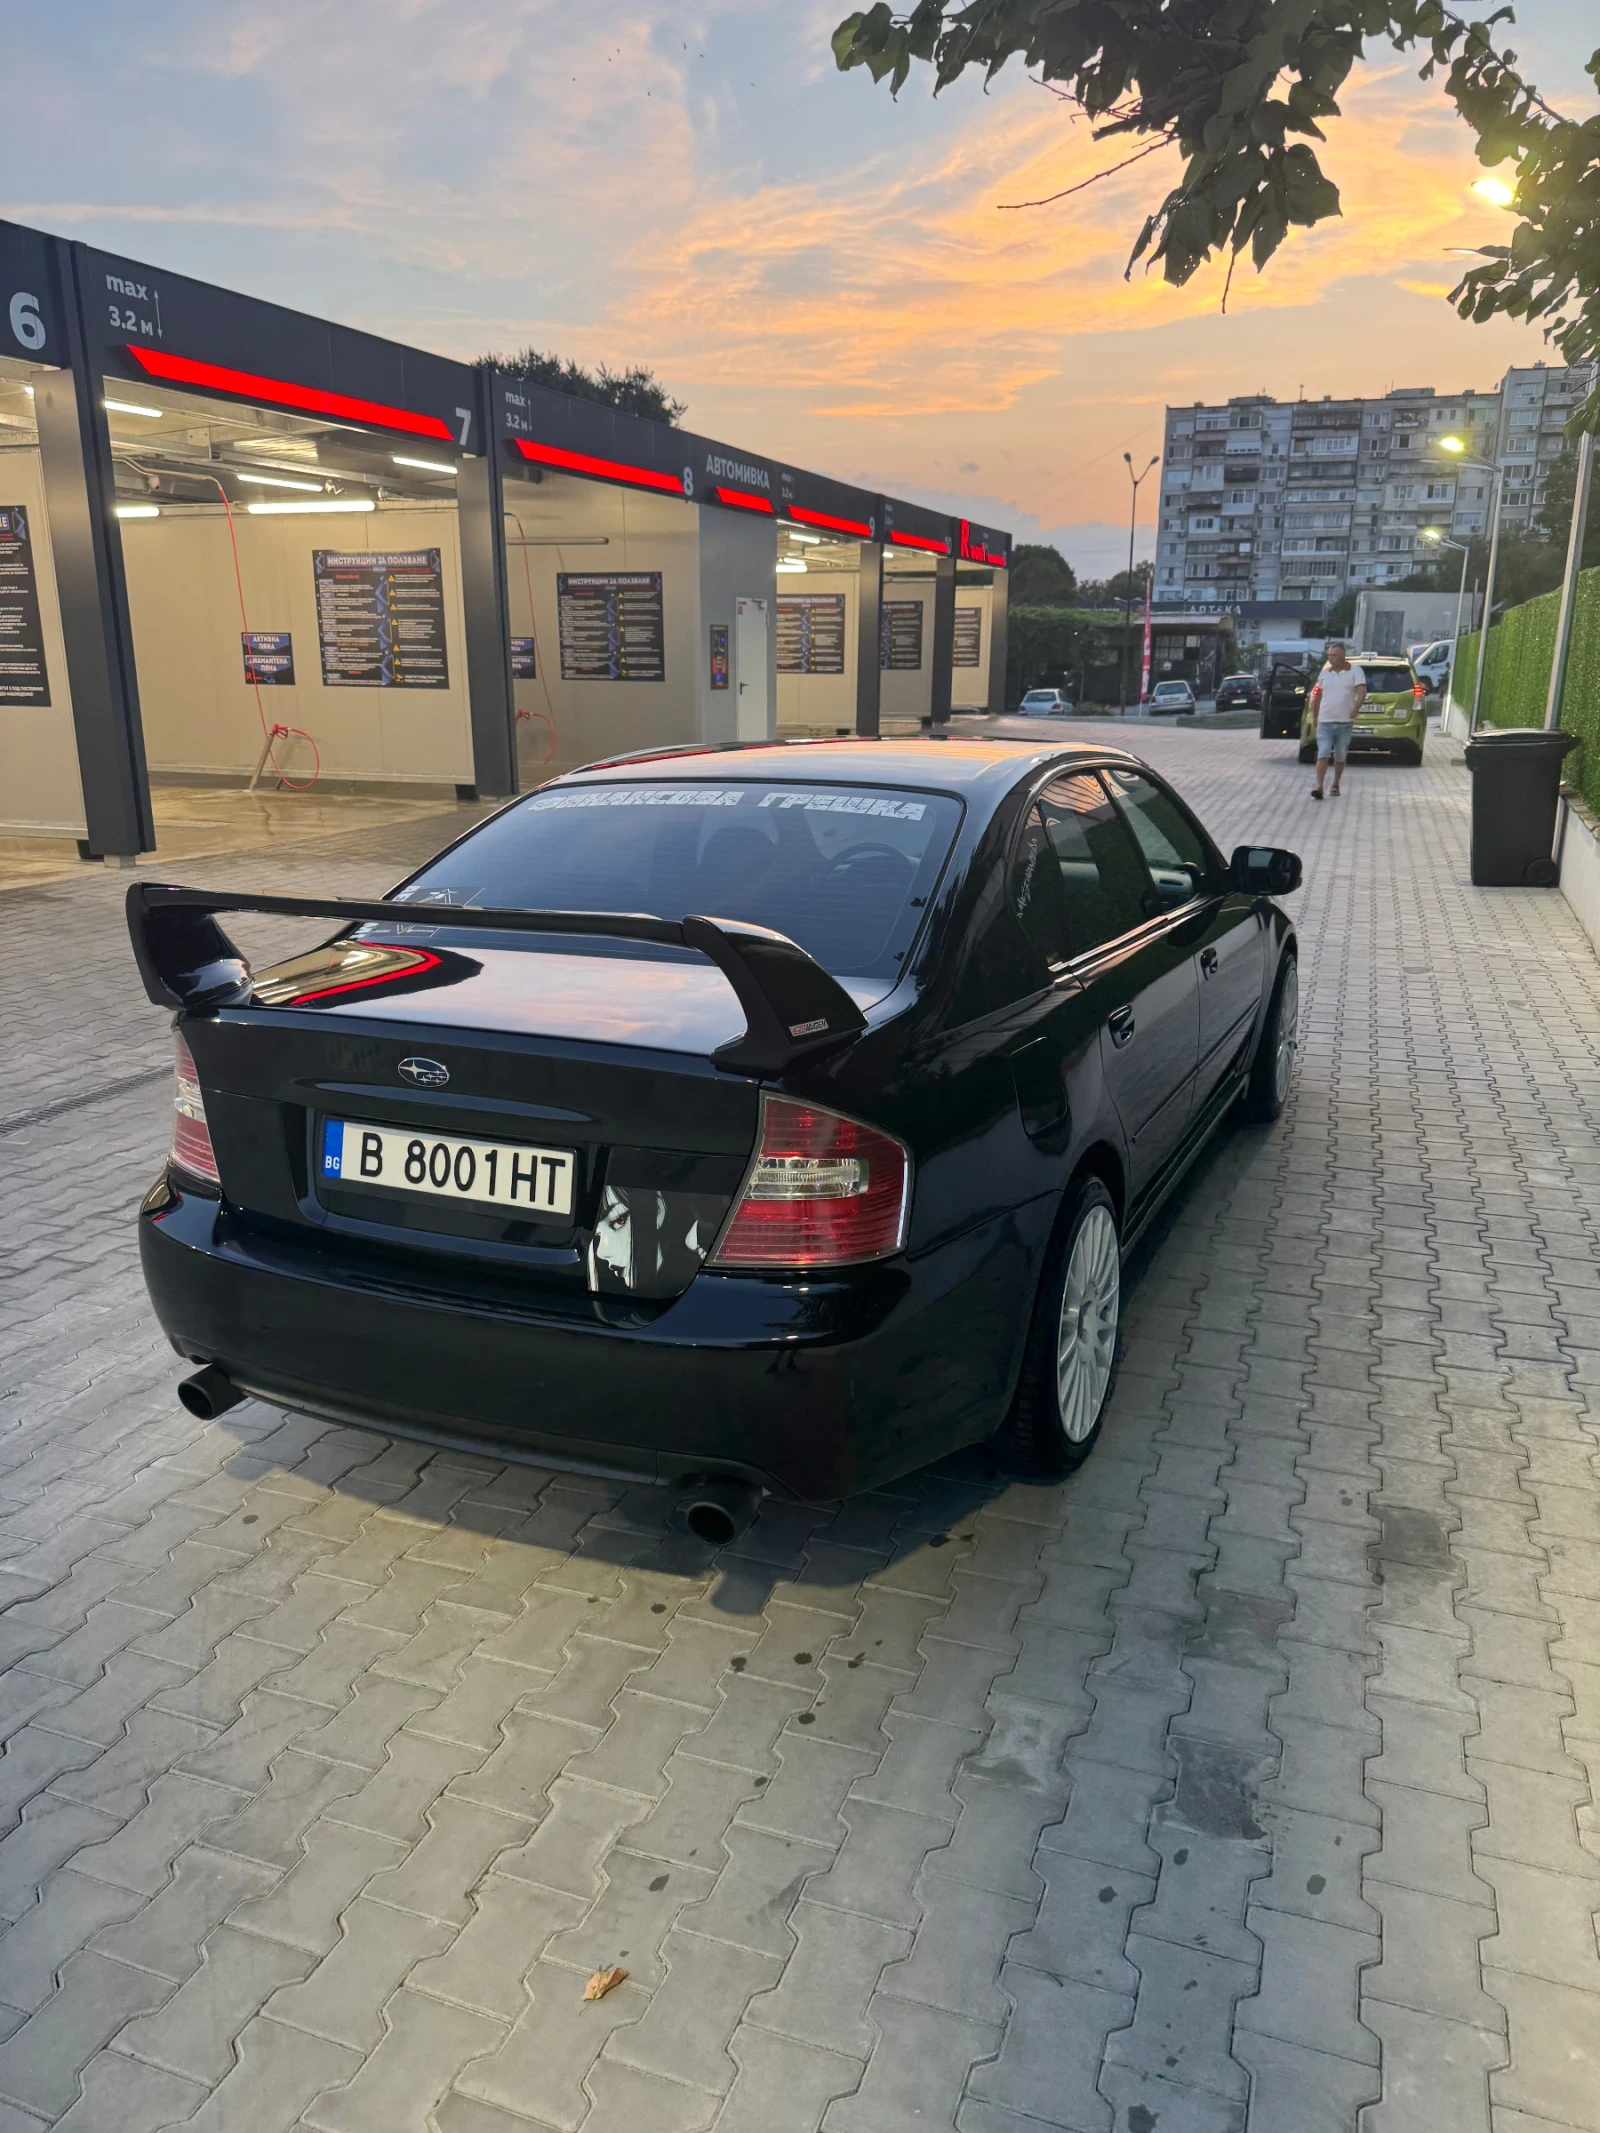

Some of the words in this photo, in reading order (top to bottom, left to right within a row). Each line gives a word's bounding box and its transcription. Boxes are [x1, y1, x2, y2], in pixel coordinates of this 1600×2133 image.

[105, 274, 149, 301] max
[9, 291, 47, 350] 6
[108, 305, 137, 332] 3.2
[505, 391, 526, 407] max
[455, 407, 471, 446] 7
[506, 412, 520, 429] 3.2
[683, 466, 694, 496] 8
[705, 454, 771, 489] АВТОМИВКА
[869, 516, 876, 538] 9
[960, 518, 970, 558] R
[327, 556, 377, 566] ИНСТРУКЦИИ
[378, 556, 387, 565] ЗА
[388, 555, 427, 565] ПОЛЗВАНЕ
[527, 790, 745, 811] ФИНАНСОВА
[757, 792, 927, 821] ГРЕШКА
[324, 1154, 341, 1171] BG
[360, 1131, 383, 1178] B
